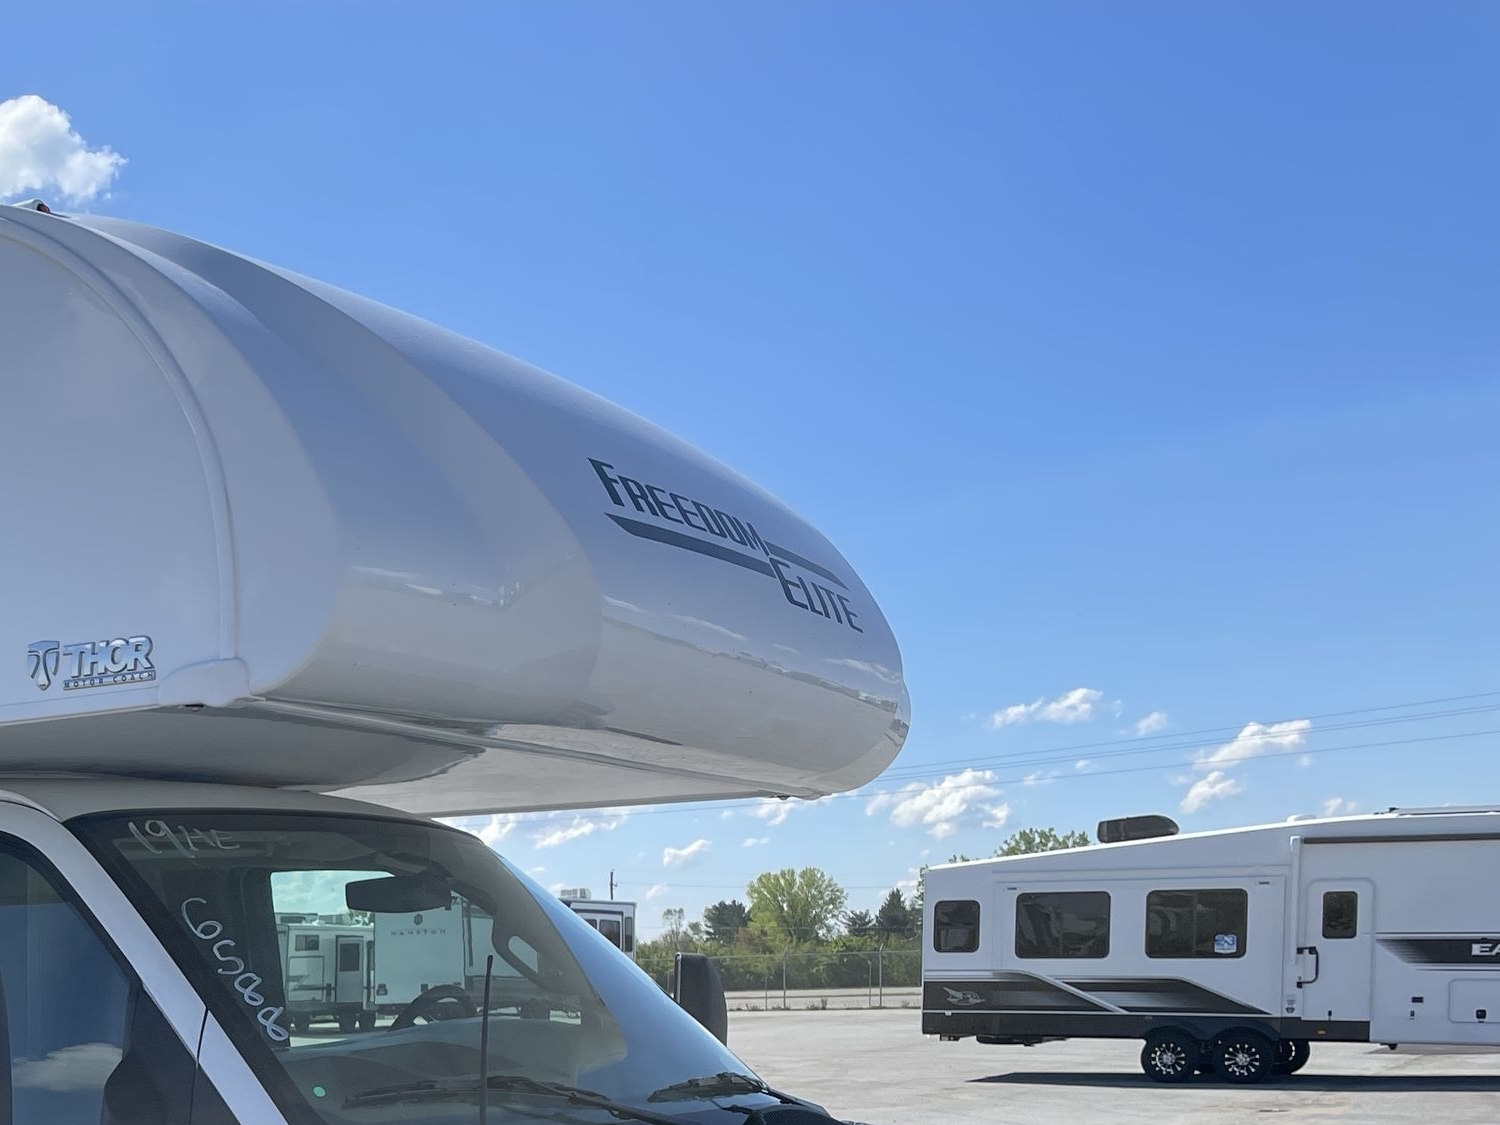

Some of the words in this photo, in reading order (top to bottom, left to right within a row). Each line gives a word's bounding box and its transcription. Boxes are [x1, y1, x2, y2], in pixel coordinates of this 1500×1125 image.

[587, 457, 771, 558] FREEDOM
[769, 557, 864, 634] ELITE
[63, 635, 156, 679] THOR
[64, 678, 104, 689] MOTOR
[113, 671, 155, 684] COACH
[181, 897, 289, 1041] 6588
